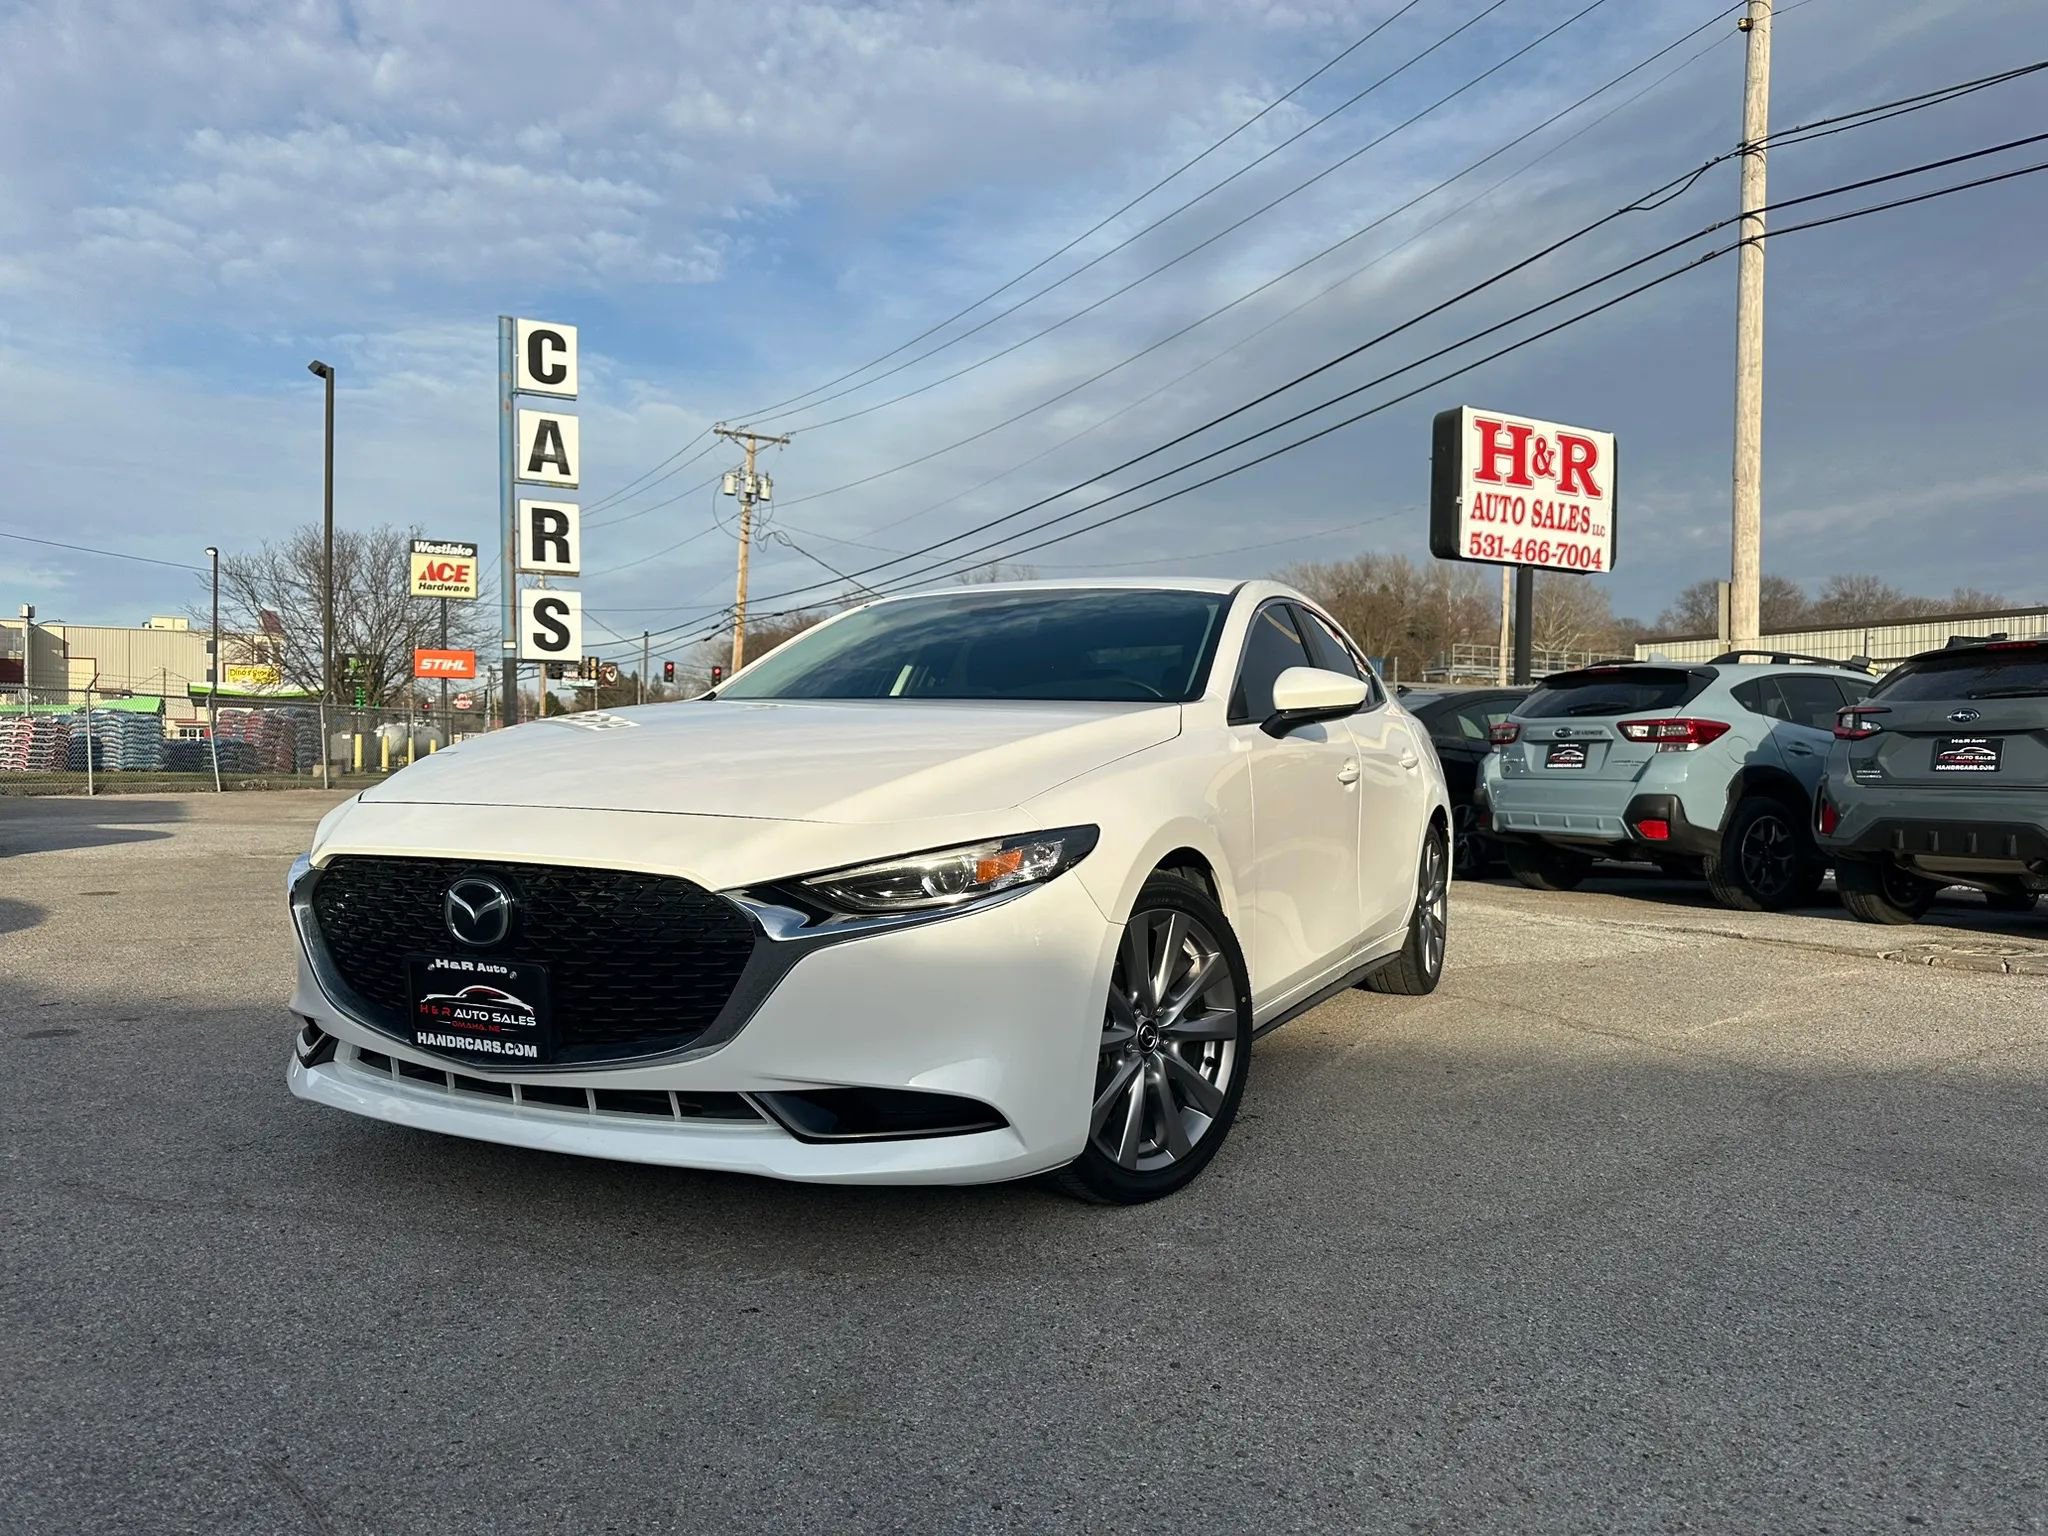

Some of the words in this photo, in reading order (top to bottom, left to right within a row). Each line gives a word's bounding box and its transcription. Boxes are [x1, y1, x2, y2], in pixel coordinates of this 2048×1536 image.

[1474, 416, 1602, 499] H&R
[526, 328, 573, 653] CARS
[1470, 492, 1525, 525] AUTO
[1531, 499, 1591, 534] SALES
[1592, 524, 1606, 538] LLC
[414, 541, 474, 557] Westlake
[1469, 532, 1603, 570] 531-466-7004
[418, 560, 470, 583] ACE
[418, 583, 470, 593] Hardware
[420, 658, 468, 671] STIHL
[435, 958, 474, 970] H&R
[477, 963, 507, 973] Auto
[419, 1004, 429, 1014] H
[431, 1006, 440, 1015] &
[441, 1006, 451, 1017] R
[454, 1008, 489, 1021] AUTO
[492, 1013, 537, 1027] SALES
[417, 1032, 537, 1057] HANDRCARS.COM
